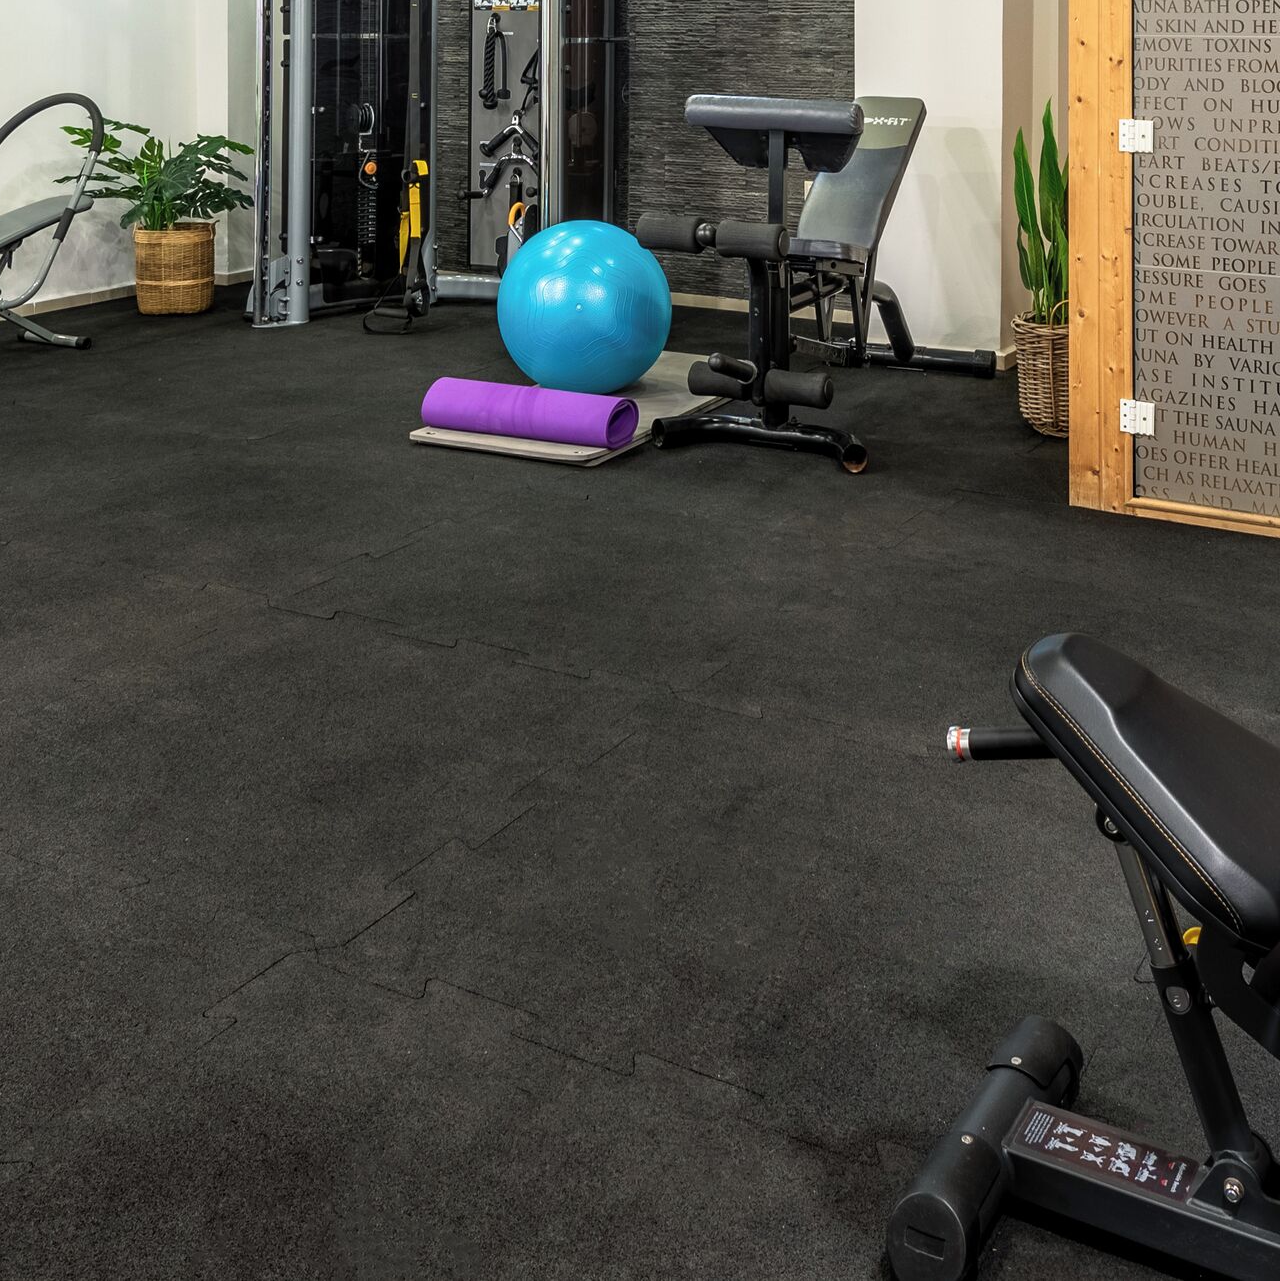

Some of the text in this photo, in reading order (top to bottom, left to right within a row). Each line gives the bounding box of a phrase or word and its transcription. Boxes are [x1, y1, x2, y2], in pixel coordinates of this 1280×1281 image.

[1184, 0, 1229, 14] BATH
[1156, 19, 1196, 33] SKIN
[1204, 19, 1244, 34] AND
[1134, 38, 1192, 52] EMOVE
[1204, 39, 1271, 54] TOXINS
[1228, 58, 1279, 73] FROM
[1184, 78, 1224, 92] AND
[1134, 96, 1188, 111] FFECT
[1204, 98, 1233, 112] ON
[1139, 155, 1185, 169] EART
[1137, 194, 1204, 211] OUBLE,
[1134, 213, 1244, 232] IRCULATION
[1261, 220, 1280, 235] IN
[1152, 253, 1200, 269] SOME
[1212, 258, 1276, 276] PEOPLE
[1219, 277, 1267, 294] GOES
[1195, 294, 1274, 314] PEOPLE
[1136, 309, 1209, 328] OWEVER
[1224, 317, 1234, 331] A
[1136, 328, 1158, 342] UT
[1166, 331, 1192, 346] ON
[1202, 334, 1272, 355] HEALTH
[1194, 354, 1214, 368] BY
[1137, 369, 1172, 384] ASE
[1138, 388, 1236, 411] AGAZINES
[1174, 410, 1209, 428] THE
[1216, 416, 1275, 436] SAUNA
[1173, 430, 1246, 452] HUMAN
[1136, 446, 1168, 462] OES
[1174, 450, 1229, 470] OFFER
[1144, 466, 1169, 481] CH
[1176, 470, 1194, 486] AS
